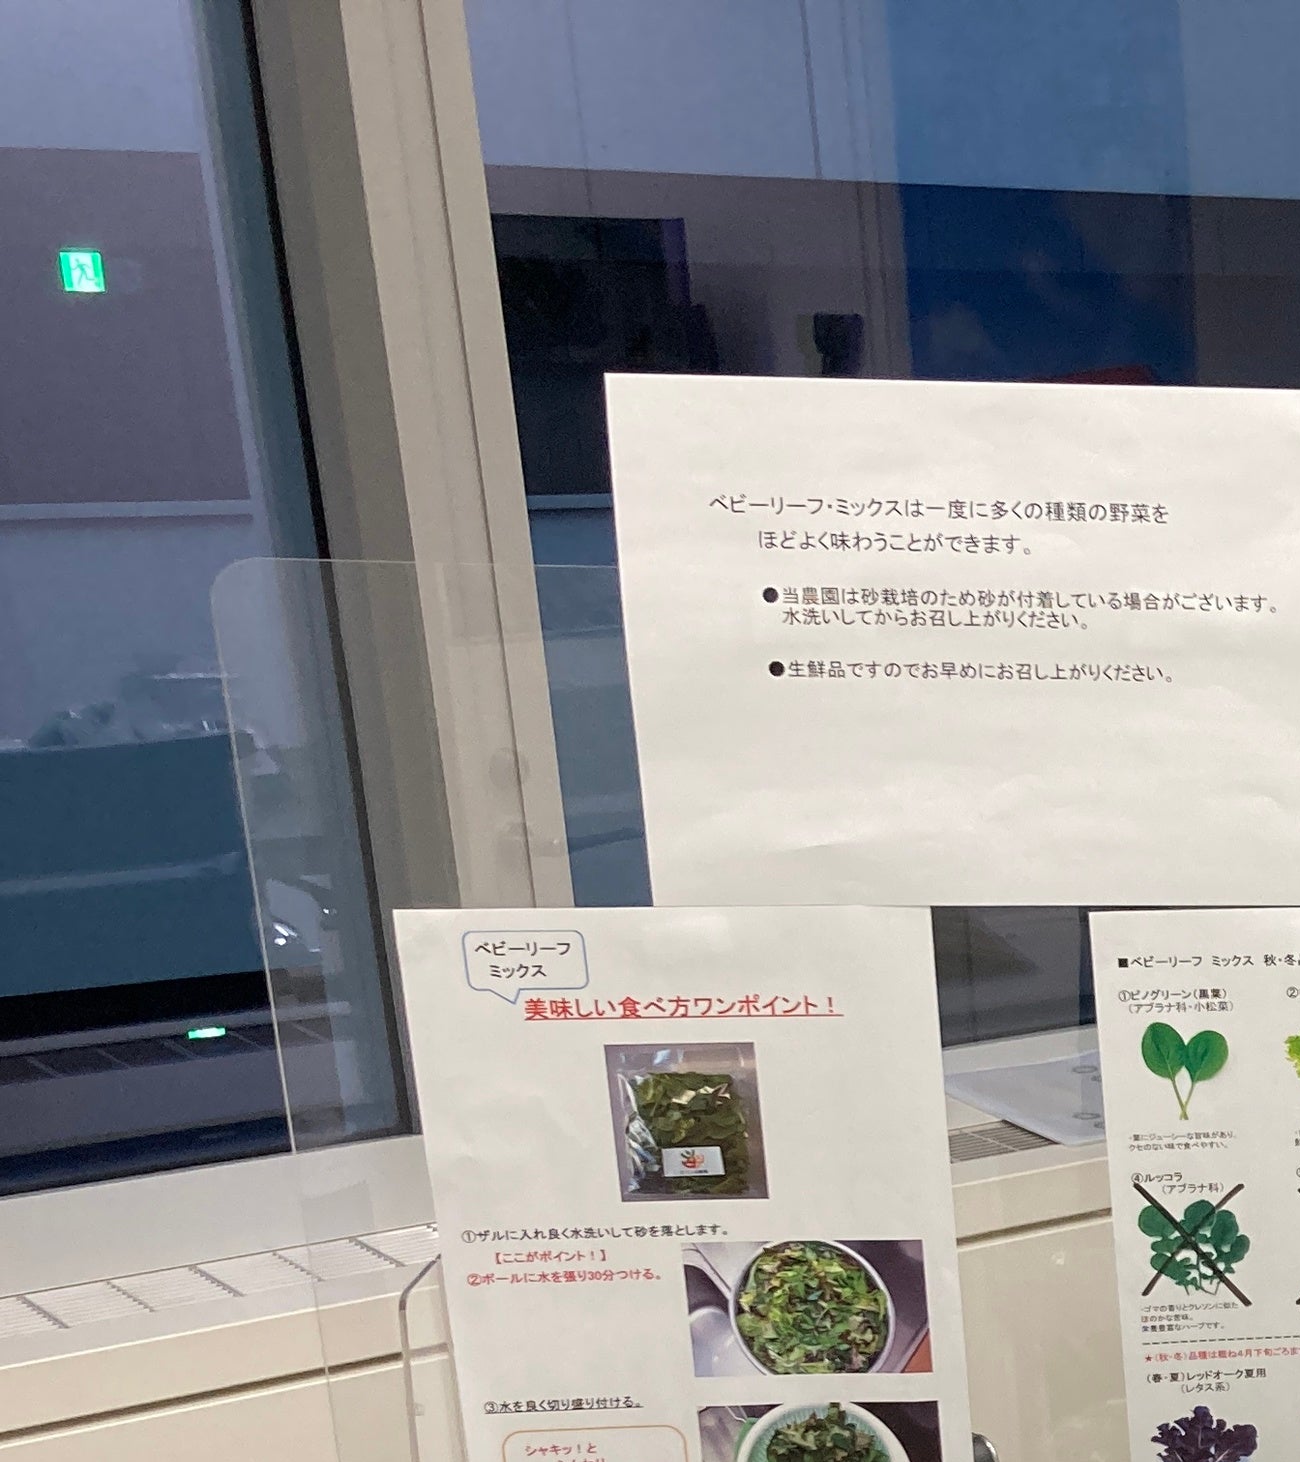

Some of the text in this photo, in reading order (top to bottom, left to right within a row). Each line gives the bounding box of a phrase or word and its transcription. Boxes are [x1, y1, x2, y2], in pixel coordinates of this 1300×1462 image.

[708, 494, 1169, 525] ベビーリーフ・ミックスは一度に多くの種類の野菜を
[757, 528, 1034, 557] ほどよく味わうことができます。
[781, 608, 1090, 631] 水洗いしてからお召し上がりください。
[474, 940, 572, 957] ベビーリーフ
[489, 964, 547, 979] ミックス
[1131, 955, 1203, 969] ベビーリーフ
[1211, 954, 1255, 967] ミックス
[524, 996, 837, 1020] 美味しい食べ方ワンポイント！
